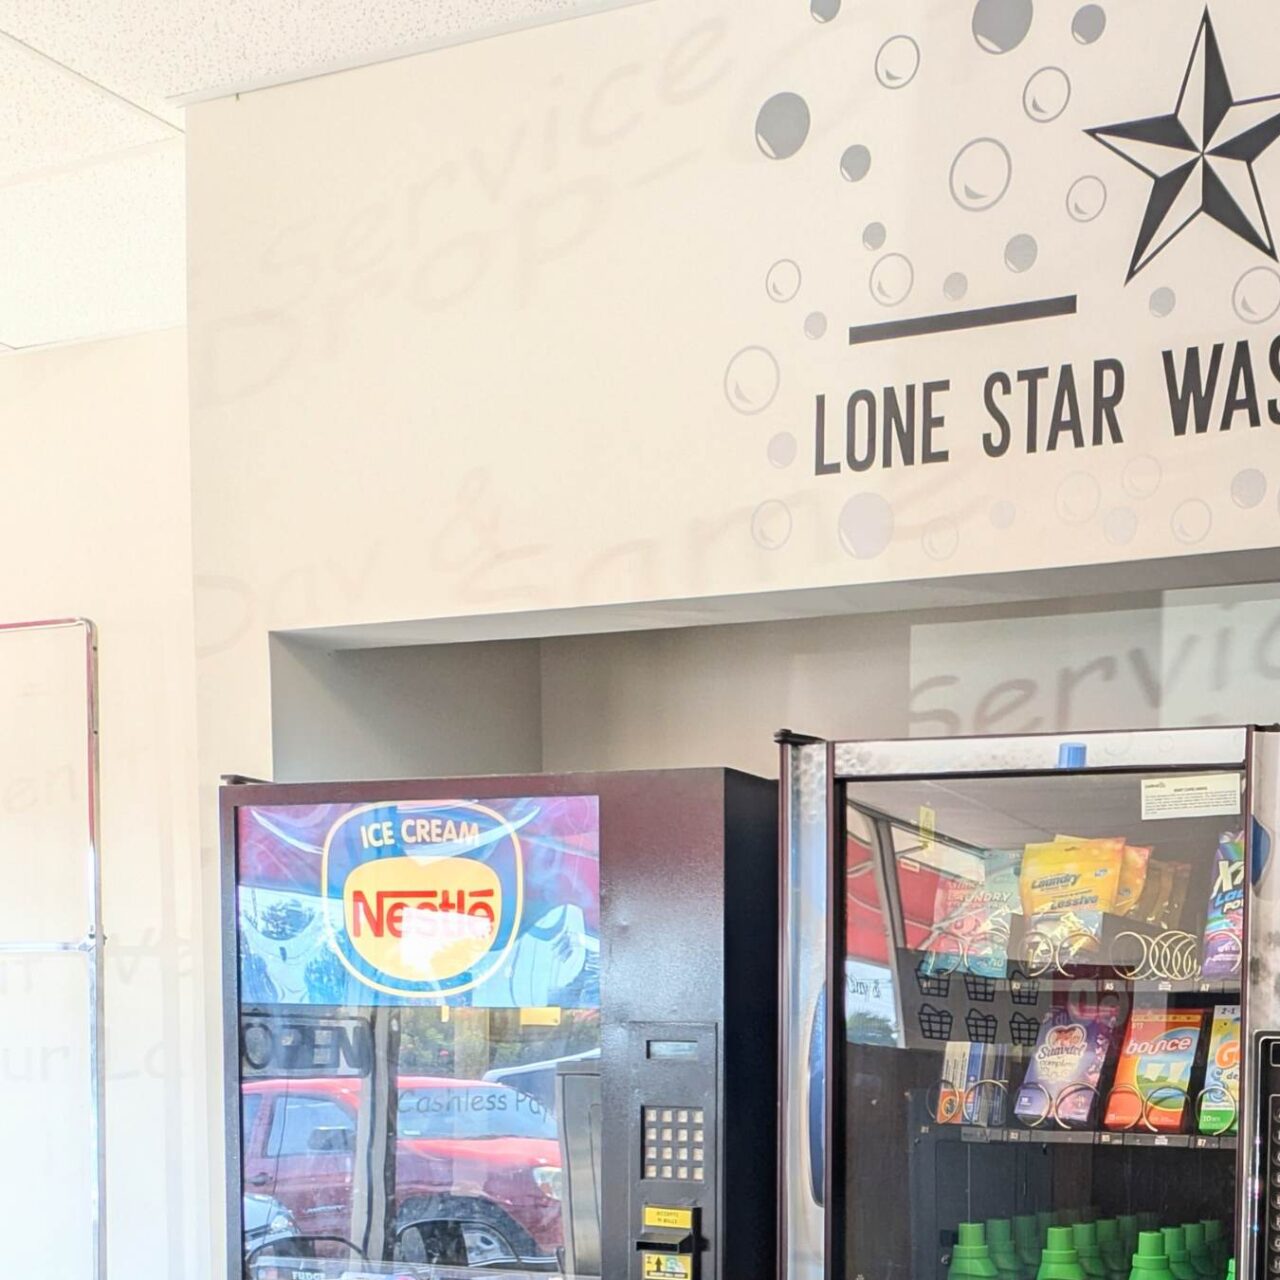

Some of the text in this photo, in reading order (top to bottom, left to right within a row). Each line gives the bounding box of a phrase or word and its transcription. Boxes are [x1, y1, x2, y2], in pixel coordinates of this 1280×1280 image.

[815, 378, 950, 476] LONE
[982, 358, 1126, 459] STAR
[360, 819, 480, 849] ICE CREAM
[1031, 873, 1081, 889] Laundry
[1126, 1037, 1191, 1055] bounce
[398, 1089, 508, 1115] Cashless
